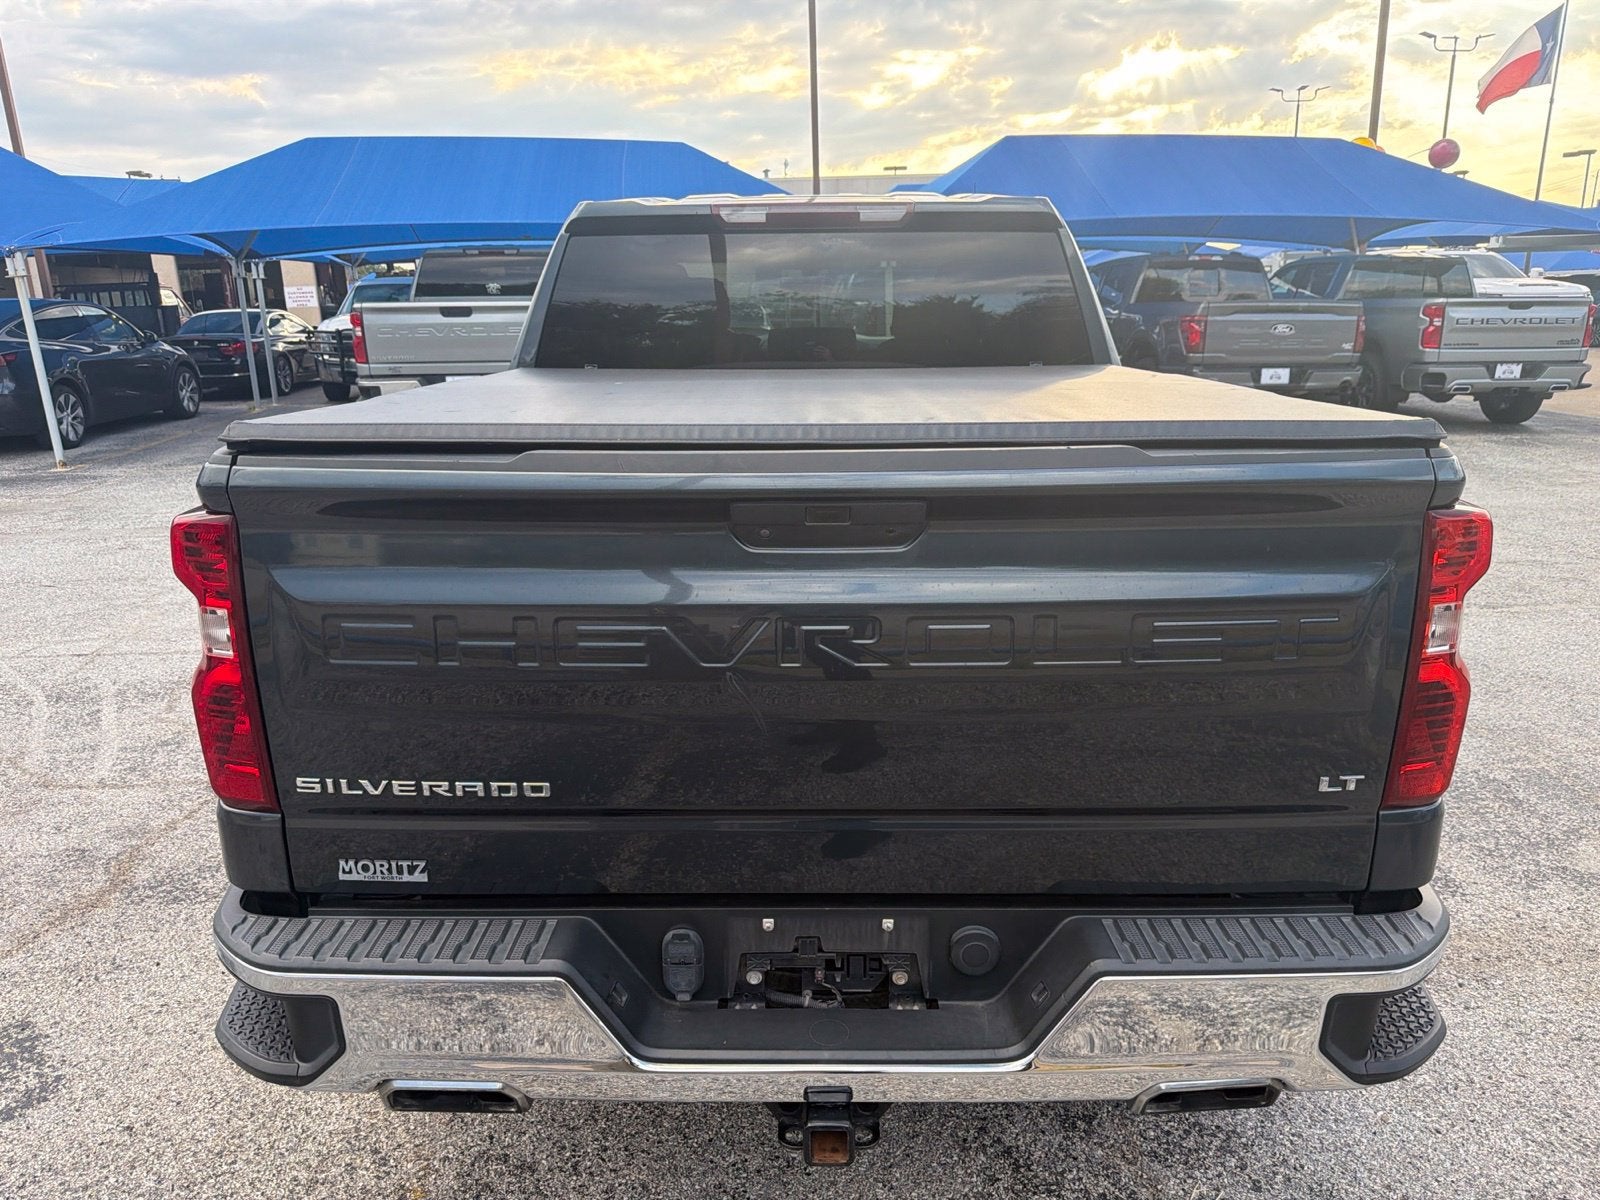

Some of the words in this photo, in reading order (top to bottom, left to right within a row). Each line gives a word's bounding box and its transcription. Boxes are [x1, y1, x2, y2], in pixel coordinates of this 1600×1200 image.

[1455, 317, 1580, 326] CHEVROLET
[376, 327, 522, 338] CHEVROLE
[321, 609, 1341, 668] CHEVROLET
[295, 777, 551, 798] SILVERADO
[1318, 775, 1366, 793] LT
[339, 858, 428, 876] MORITZ
